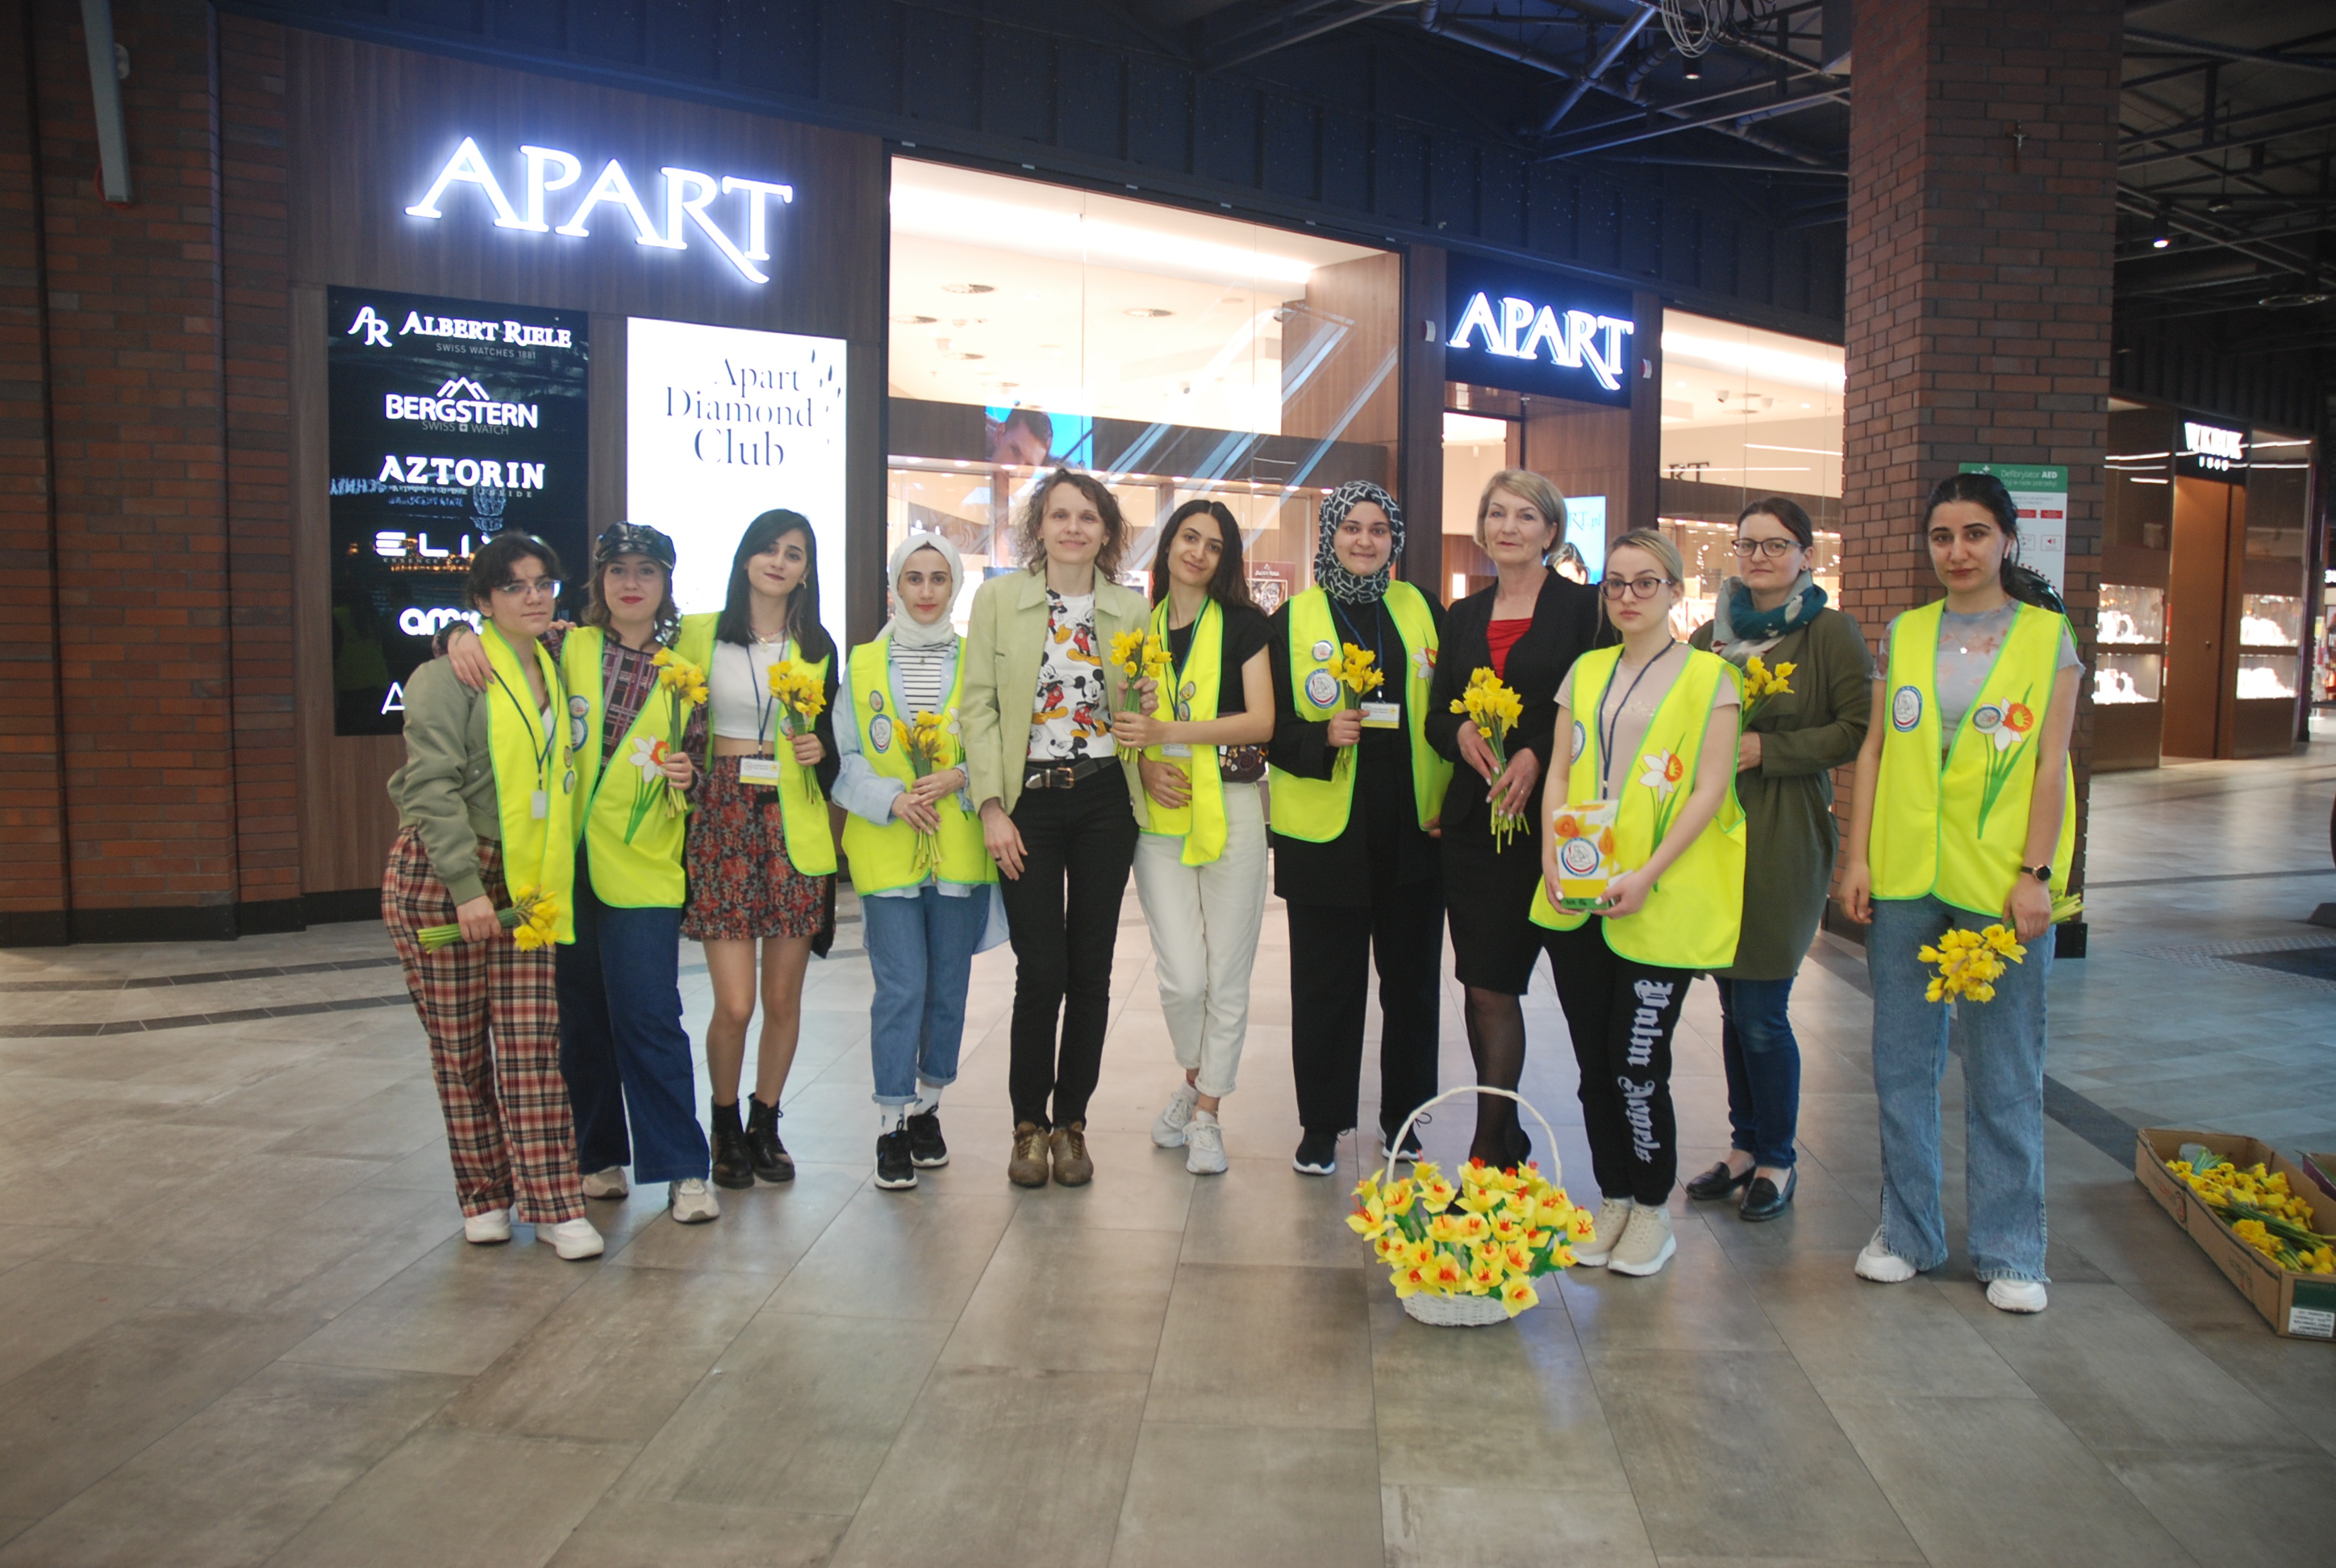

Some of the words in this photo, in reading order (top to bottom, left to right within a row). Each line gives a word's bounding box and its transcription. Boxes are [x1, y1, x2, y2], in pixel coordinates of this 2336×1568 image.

[405, 136, 793, 284] APART
[399, 311, 499, 341] ALBERT
[503, 320, 572, 348] RIELE
[1445, 291, 1635, 390] APART
[436, 343, 467, 353] SWISS
[469, 346, 515, 357] WATCHES
[518, 350, 536, 360] 1881
[715, 358, 800, 398] Apart
[385, 394, 539, 428] BERGSTERN
[667, 386, 812, 427] Diamond
[422, 421, 456, 432] SWISS
[471, 423, 509, 435] WATCH
[695, 428, 784, 466] Club
[379, 455, 545, 490] AZTORIN
[1669, 462, 1709, 483] RT
[2042, 471, 2059, 479] AED
[482, 489, 532, 498] INSIDE
[1568, 511, 1602, 531] RT.pl
[375, 532, 491, 558] ELI
[1617, 1076, 1661, 1164] Angels
